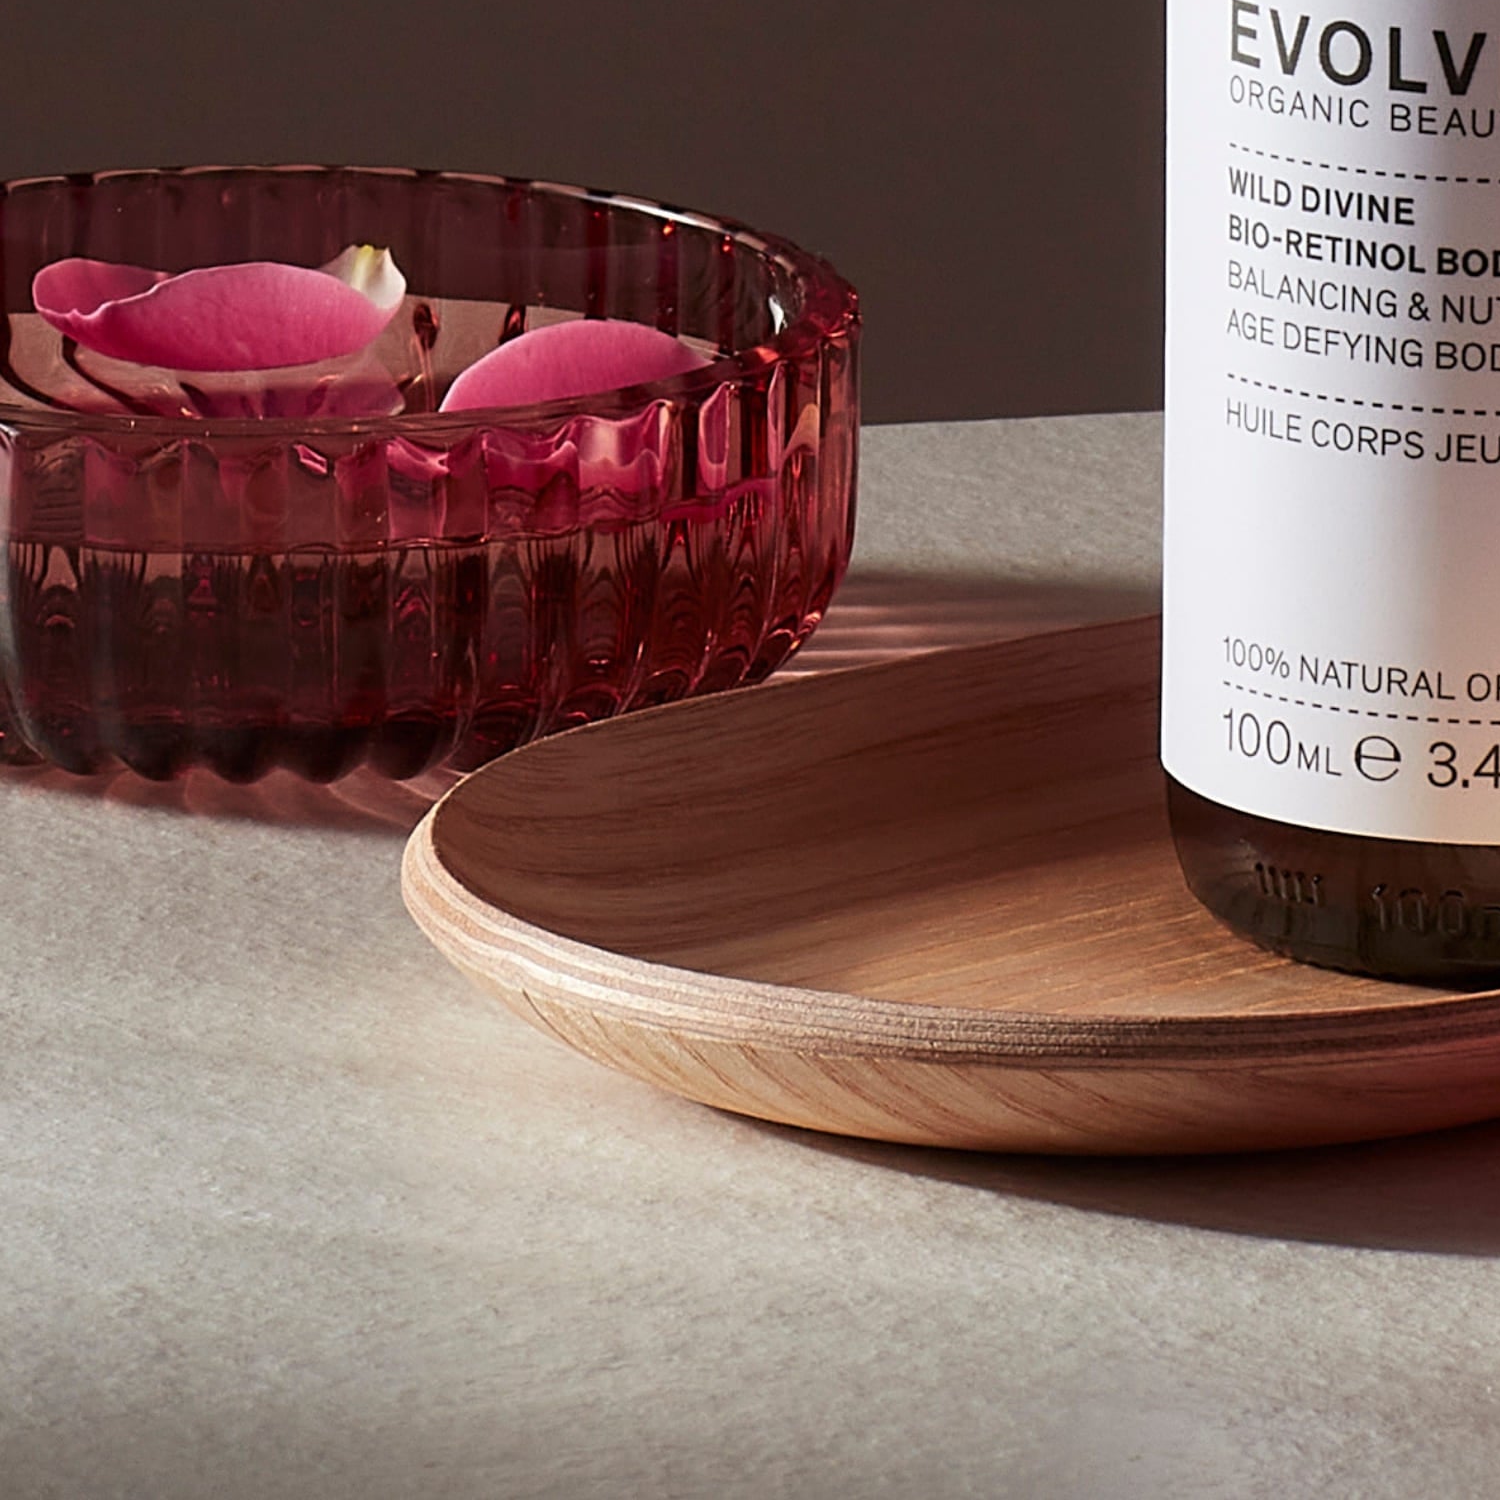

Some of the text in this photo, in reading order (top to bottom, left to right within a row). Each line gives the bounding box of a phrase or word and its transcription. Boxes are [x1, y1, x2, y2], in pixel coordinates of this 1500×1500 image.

[1231, 75, 1369, 128] ORGANIC
[1229, 167, 1415, 226] WILD DIVINE
[1229, 214, 1426, 274] BIO-RETINOL
[1229, 260, 1397, 318] BALANCING
[1408, 291, 1431, 322] &
[1228, 309, 1274, 345] AGE
[1284, 322, 1423, 368] DEFYING
[1227, 399, 1302, 443] HUILE
[1312, 419, 1424, 460] CORPS
[1223, 636, 1290, 678] 100%
[1300, 655, 1456, 700] NATURAL
